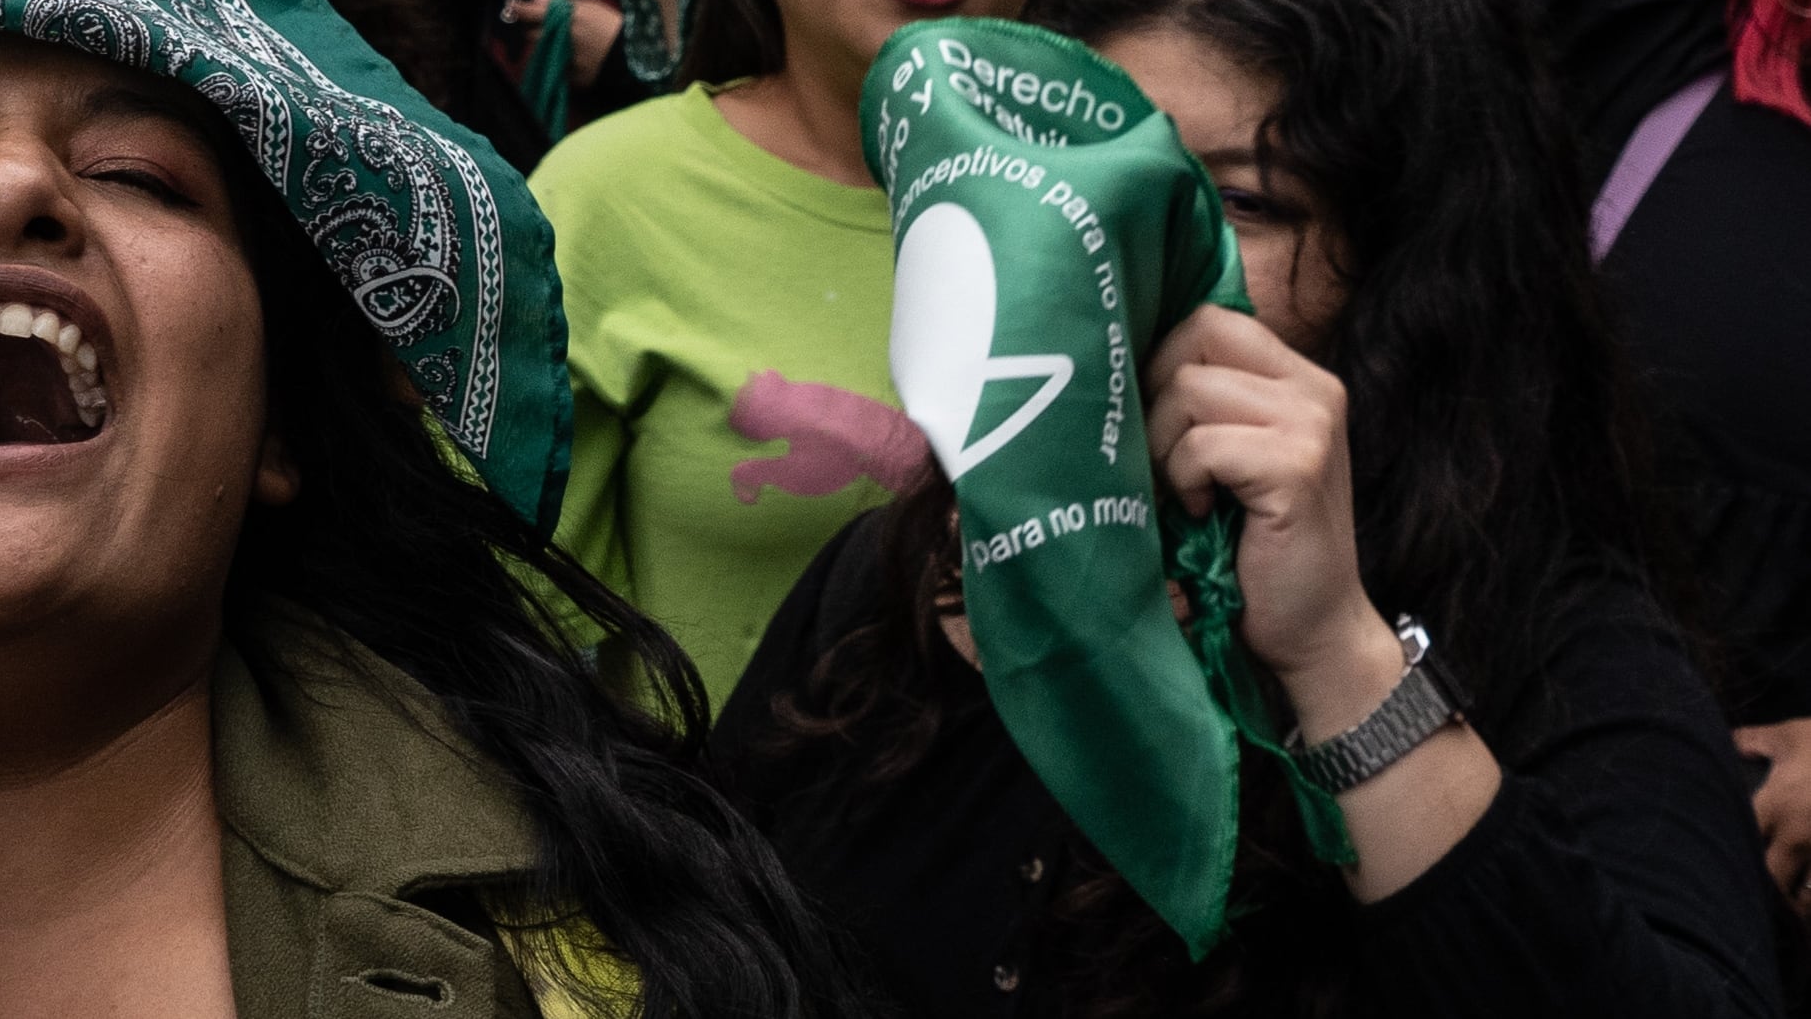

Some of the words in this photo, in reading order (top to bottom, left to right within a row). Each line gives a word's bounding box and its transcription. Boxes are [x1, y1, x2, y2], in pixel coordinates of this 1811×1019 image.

[892, 46, 926, 93] el
[939, 38, 1125, 131] Derecho
[910, 78, 934, 116] y
[1039, 180, 1107, 256] para
[1094, 261, 1119, 311] no
[1099, 321, 1128, 466] abortar
[969, 516, 1047, 576] para
[1048, 502, 1087, 539] no
